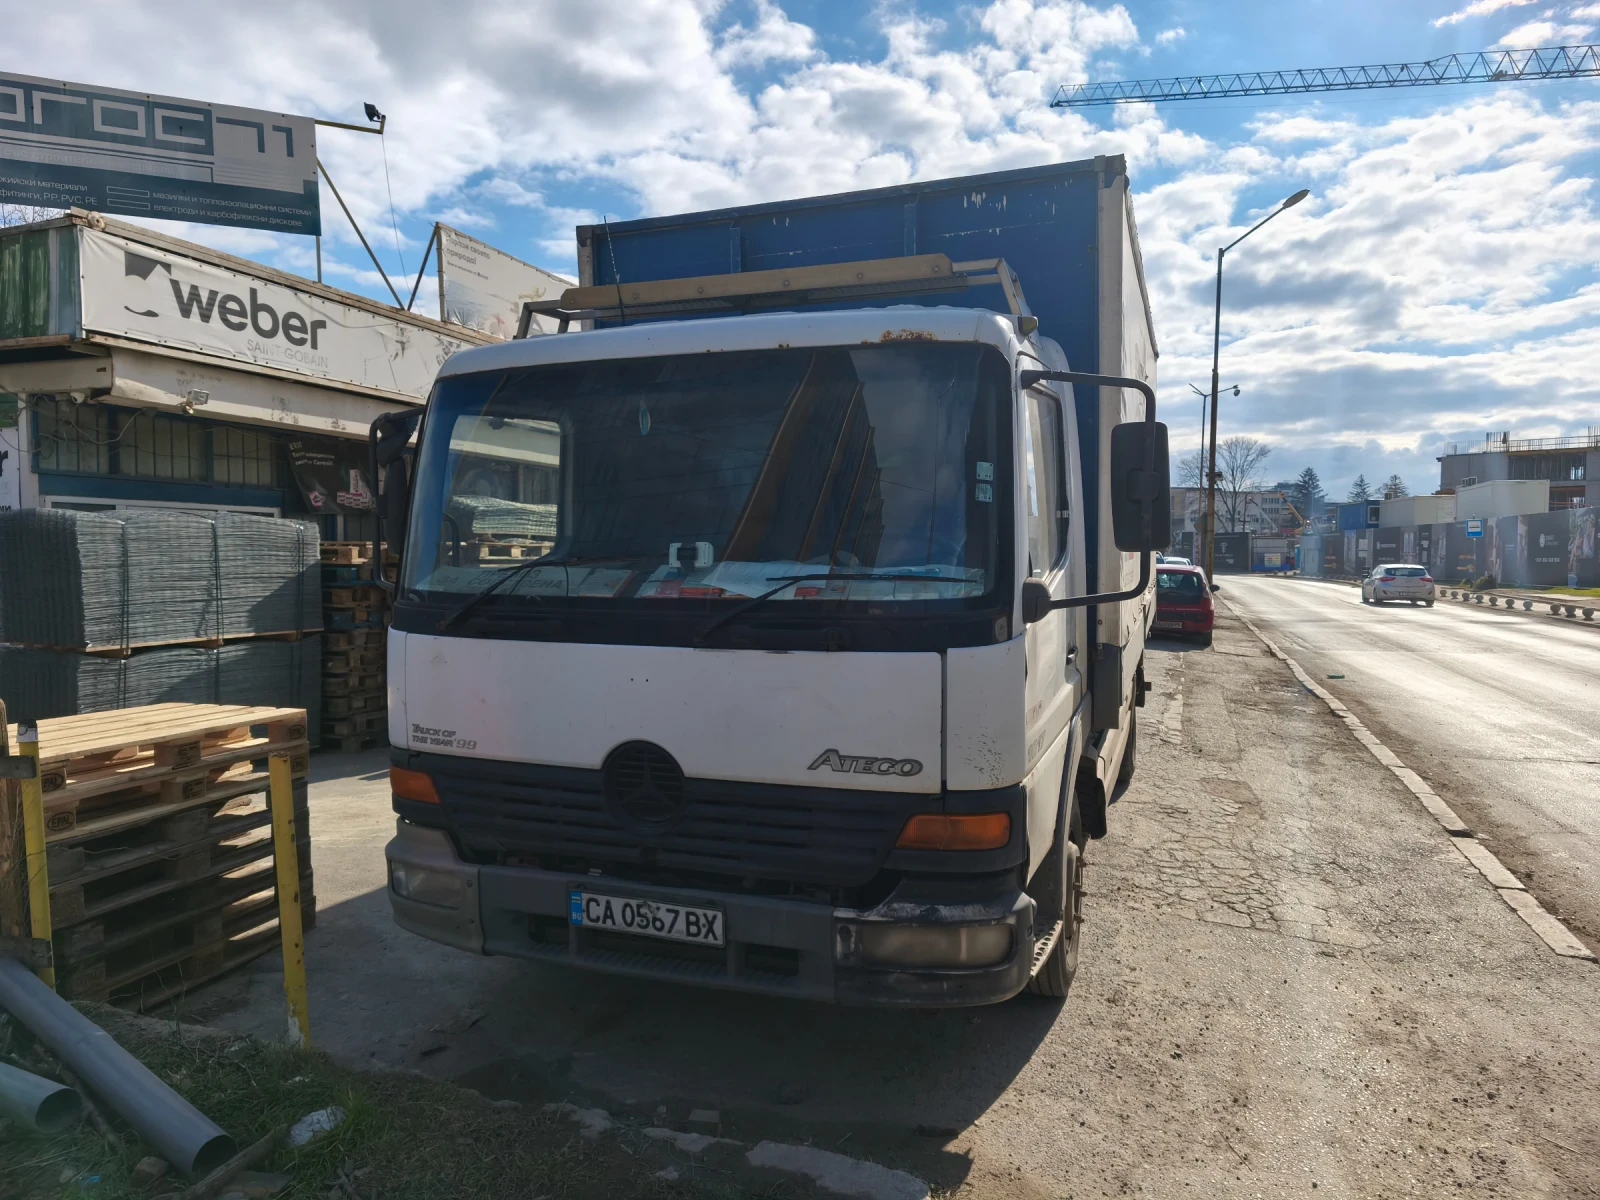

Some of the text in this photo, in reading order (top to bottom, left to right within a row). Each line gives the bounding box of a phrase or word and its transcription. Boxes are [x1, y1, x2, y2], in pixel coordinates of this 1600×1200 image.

[37, 181, 88, 192] материали
[61, 194, 84, 205] PVC,
[85, 196, 98, 205] PE
[152, 192, 191, 202] мазилки
[198, 197, 276, 211] топлоизолационни
[278, 206, 312, 216] системи
[153, 204, 199, 216] електроди
[269, 216, 302, 227] дискове
[169, 277, 327, 350] weber
[412, 723, 456, 738] TRUCK OF
[412, 735, 428, 744] THE
[571, 911, 582, 920] BG
[621, 901, 680, 935] 0567
